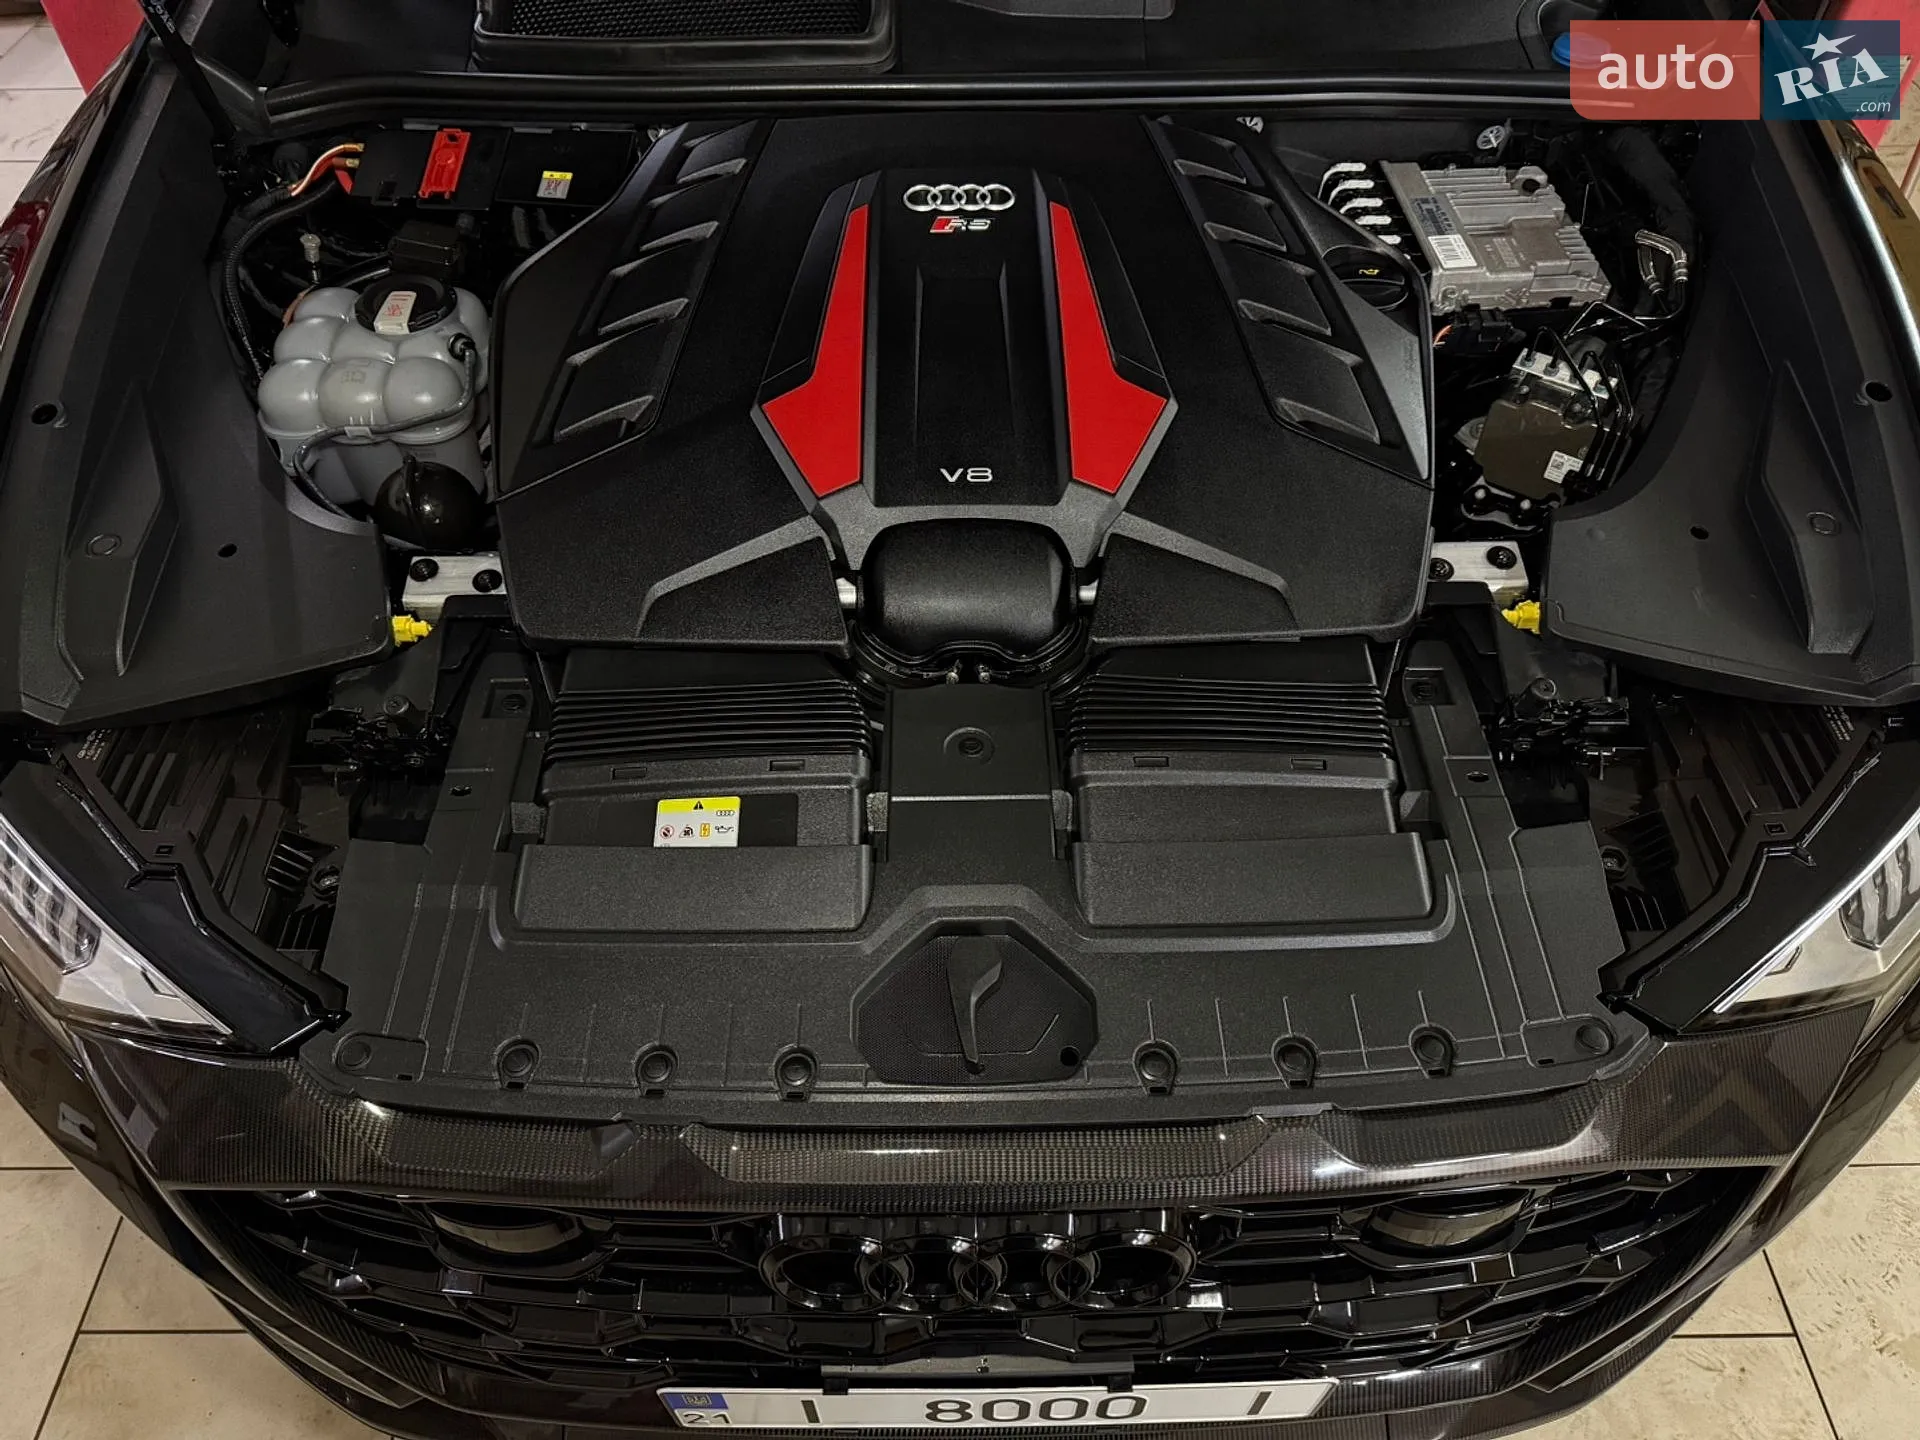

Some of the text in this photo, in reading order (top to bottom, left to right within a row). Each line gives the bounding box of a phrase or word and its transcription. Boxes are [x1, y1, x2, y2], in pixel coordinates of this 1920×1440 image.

[931, 216, 992, 232] RS
[939, 467, 993, 483] V8
[925, 1395, 1148, 1423] 8000
[683, 1412, 731, 1425] 21
